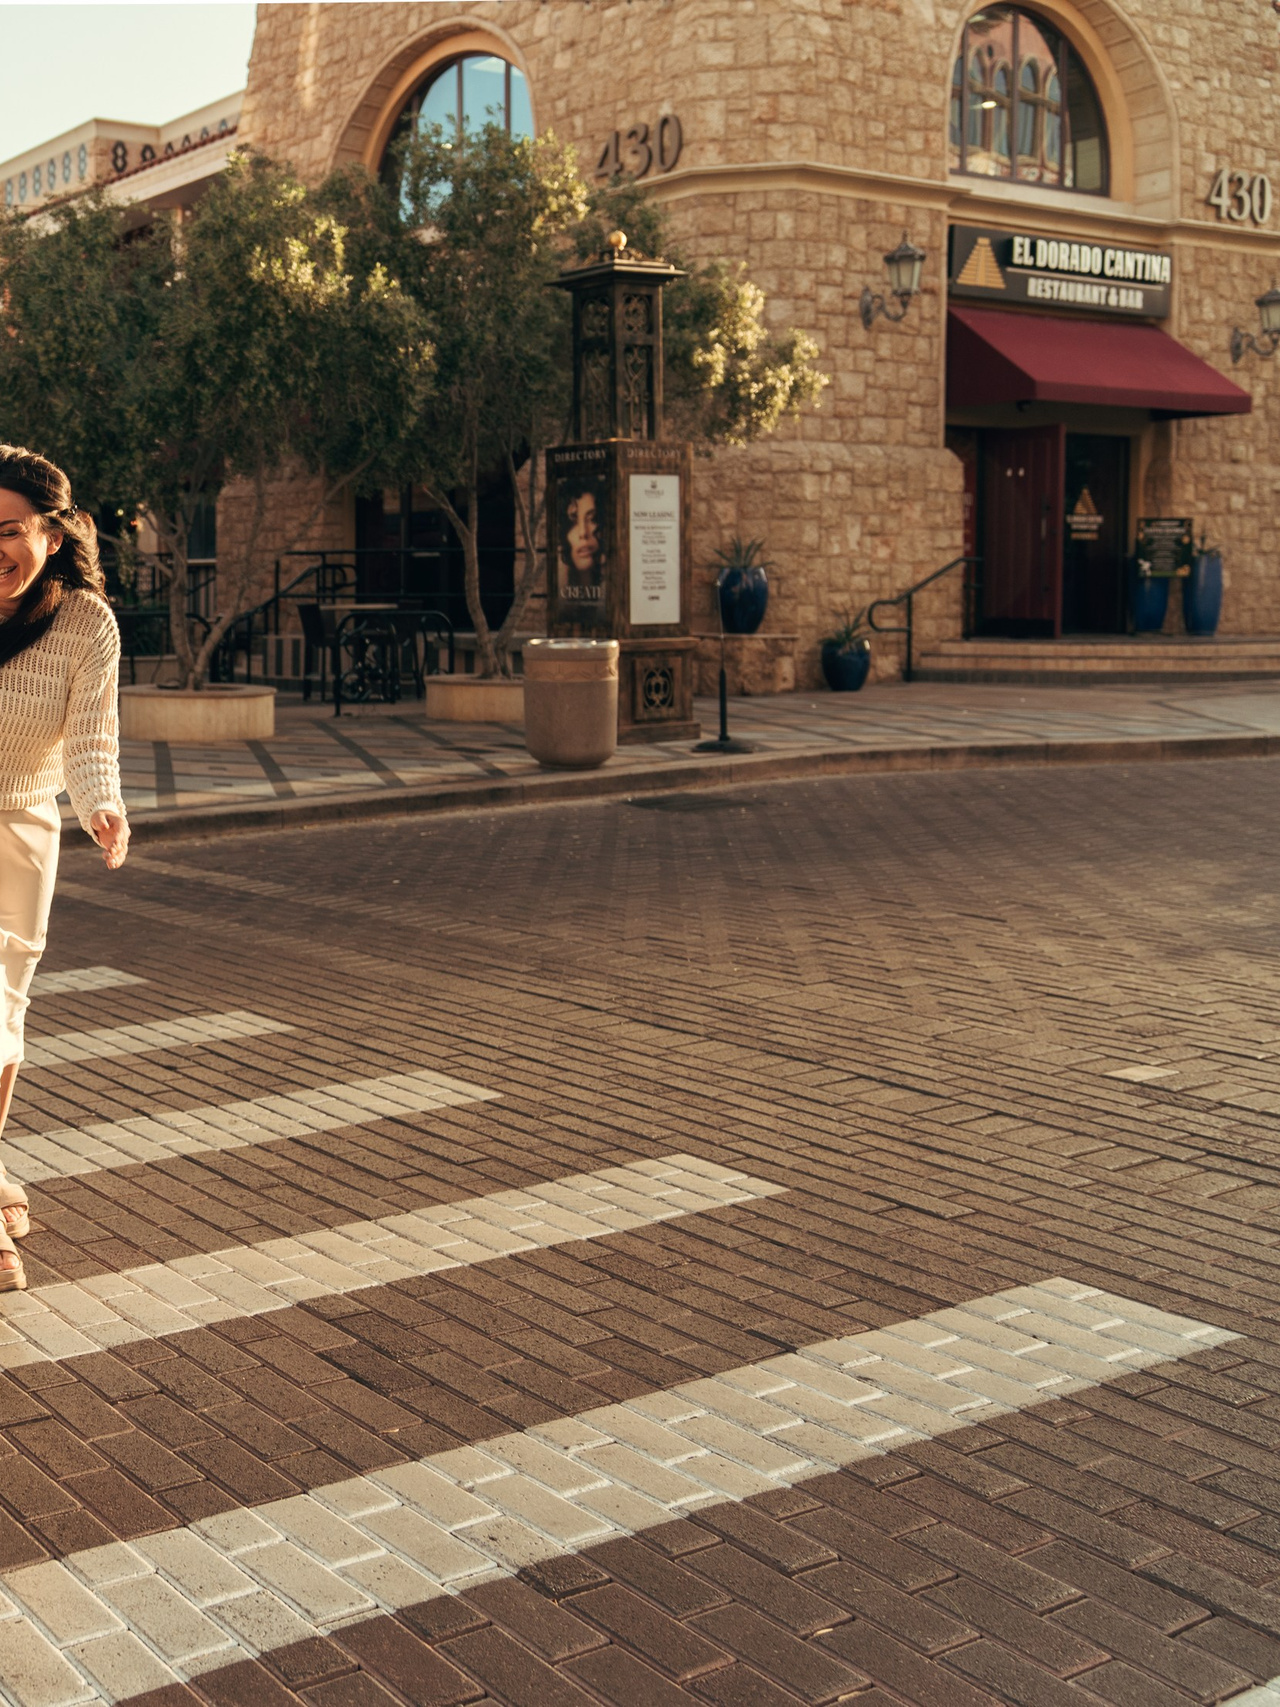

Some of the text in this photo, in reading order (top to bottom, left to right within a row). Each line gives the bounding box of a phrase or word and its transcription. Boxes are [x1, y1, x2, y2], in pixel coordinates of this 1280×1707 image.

[594, 114, 682, 180] 430
[1208, 167, 1272, 224] 430
[1012, 236, 1171, 284] EL DORADO CANTINA
[1027, 277, 1144, 309] RESTAURANT & BAR
[554, 448, 606, 463] DIRECTORY
[626, 447, 680, 459] DIRECTORY
